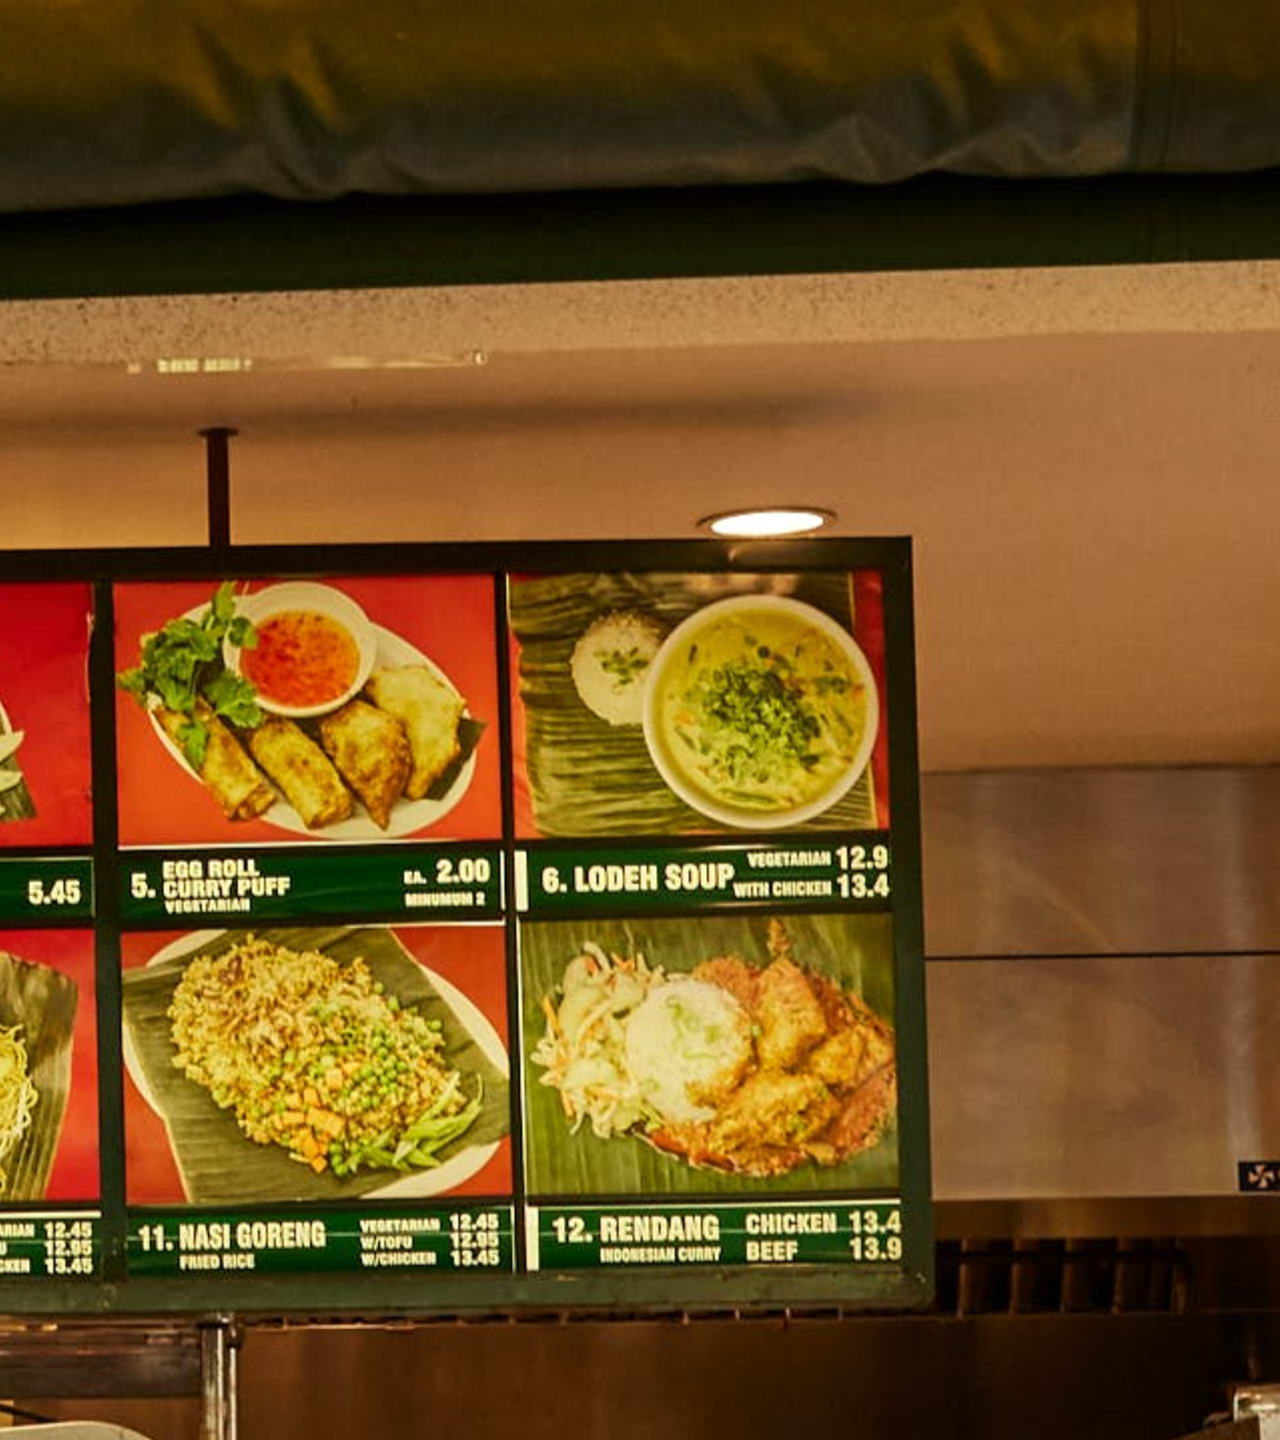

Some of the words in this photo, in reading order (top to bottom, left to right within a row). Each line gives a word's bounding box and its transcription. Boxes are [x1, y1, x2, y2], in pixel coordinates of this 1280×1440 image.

[162, 861, 204, 879] EGG
[208, 859, 260, 878] ROLL
[747, 851, 831, 868] VEGETARIAN
[403, 870, 427, 885] EA.
[436, 859, 490, 884] 2.00
[542, 868, 567, 893] 6.
[574, 865, 657, 892] LODEH
[664, 863, 735, 891] SOUP
[28, 880, 80, 905] 5.45
[130, 874, 156, 899] 5.
[162, 879, 234, 899] CURRY
[237, 877, 290, 897] PUFF
[733, 882, 769, 898] WITH
[772, 881, 832, 897] CHICKEN
[476, 892, 486, 905] 2
[44, 1222, 92, 1238] 12.45
[360, 1218, 441, 1233] VEGETARIAN
[450, 1214, 498, 1230] 12.45
[552, 1216, 593, 1243] 12.
[600, 1214, 719, 1241] RENDANG
[745, 1213, 837, 1235] CHICKEN
[138, 1225, 174, 1251] 11.
[179, 1224, 231, 1251] NASI
[236, 1221, 326, 1248] GORENG
[360, 1251, 436, 1266] W/CHICKEN
[451, 1250, 499, 1266] 13.45
[600, 1247, 677, 1263] INDONESIAN
[679, 1246, 721, 1262] CURRY
[746, 1240, 798, 1262] BEEF
[44, 1258, 93, 1273] 13.45
[179, 1254, 220, 1270] FRIED
[223, 1254, 255, 1269] RICE
